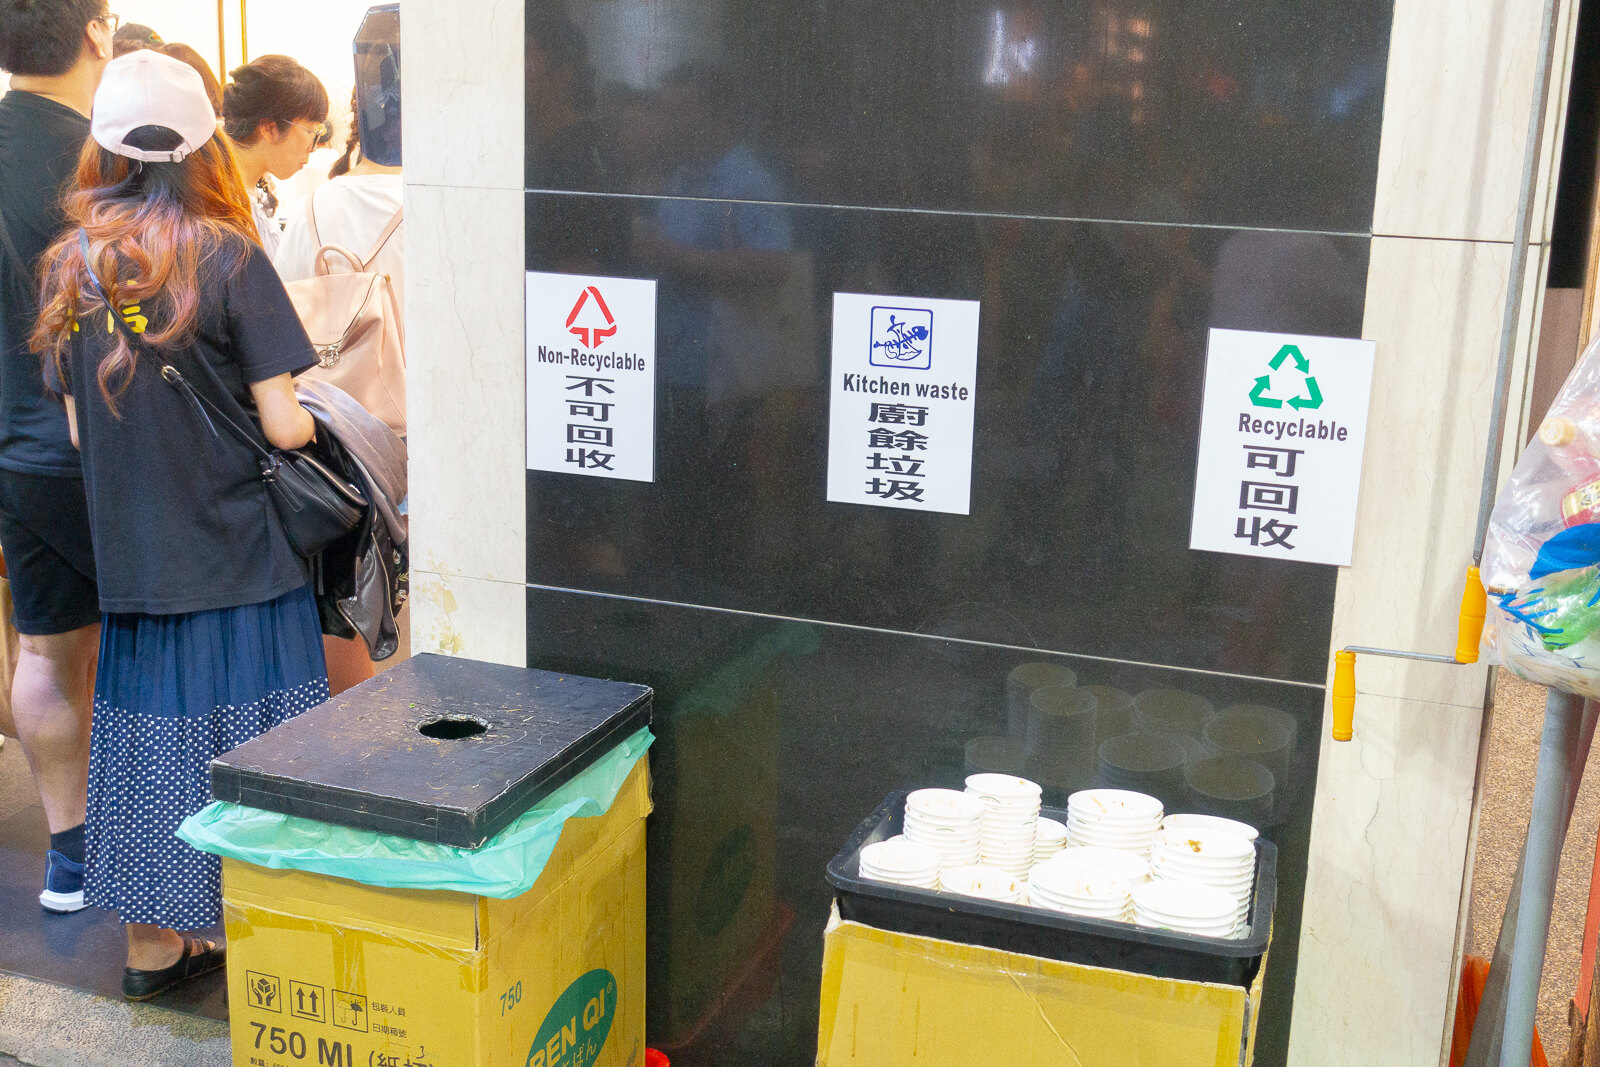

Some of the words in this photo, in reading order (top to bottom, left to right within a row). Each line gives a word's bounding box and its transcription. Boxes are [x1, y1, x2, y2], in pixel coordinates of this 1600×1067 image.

[538, 345, 645, 371] Non-Recyclable
[843, 373, 910, 396] Kitchen
[916, 382, 969, 401] waste
[565, 375, 615, 471] 不可回收
[1238, 413, 1348, 441] Recyclable
[865, 402, 929, 503] 廚餘垃圾
[1234, 444, 1305, 550] 可回收
[371, 1001, 406, 1017] 包裝人員
[500, 980, 522, 1017] 750
[583, 988, 605, 1031] QI
[250, 1021, 307, 1060] 750
